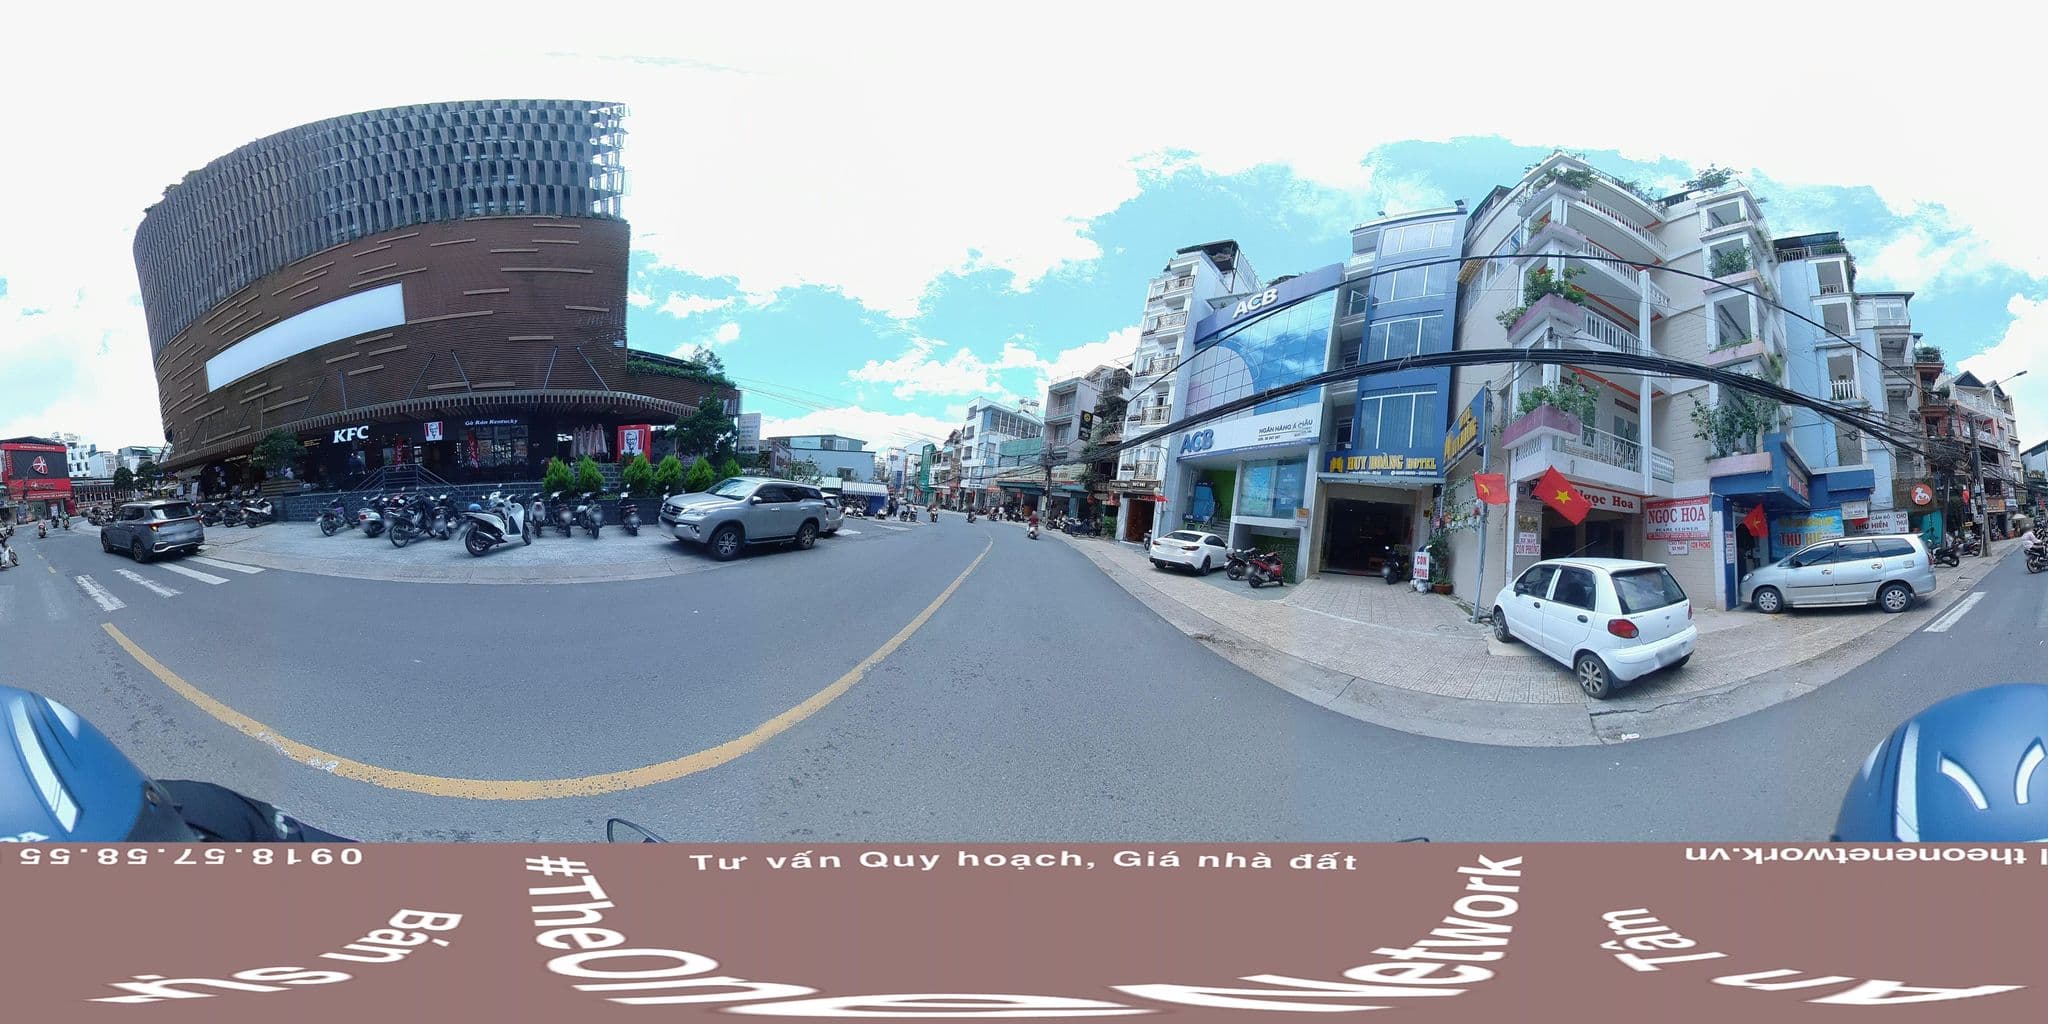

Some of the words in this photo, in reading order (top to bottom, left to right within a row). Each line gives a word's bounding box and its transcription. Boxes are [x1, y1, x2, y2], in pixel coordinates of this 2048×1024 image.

[1232, 288, 1278, 318] ACB
[333, 425, 369, 444] KFC
[1180, 428, 1214, 455] ACB
[1347, 456, 1368, 470] HUY
[1369, 452, 1404, 470] HOÀNG
[1406, 457, 1437, 470] HOTEL
[1579, 490, 1606, 507] gọc
[1612, 496, 1633, 509] Hoa
[1648, 509, 1678, 527] NGỌC
[1681, 506, 1706, 522] HOA
[1781, 532, 1802, 547] THU
